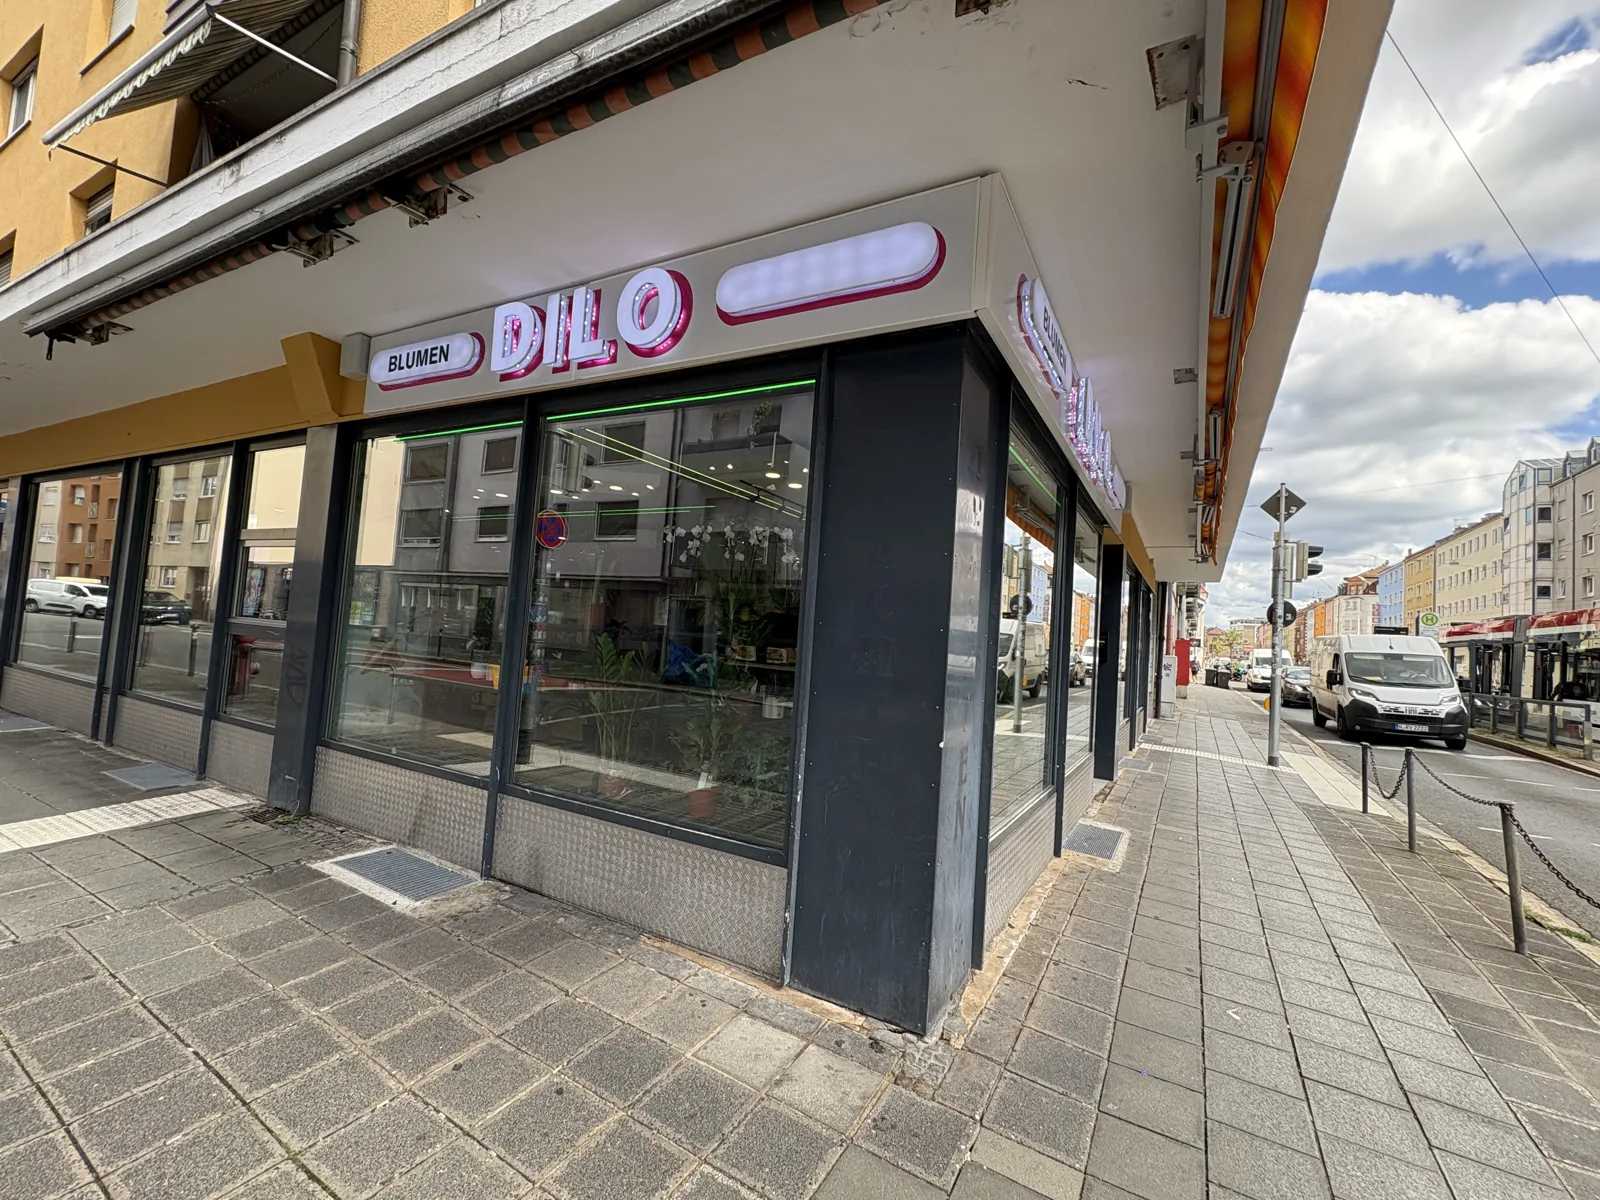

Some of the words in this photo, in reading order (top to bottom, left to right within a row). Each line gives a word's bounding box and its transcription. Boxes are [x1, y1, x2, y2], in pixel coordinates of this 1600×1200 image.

[491, 267, 683, 374] DILO
[1043, 305, 1067, 375] BLUMEN
[388, 344, 450, 373] BLUMEN
